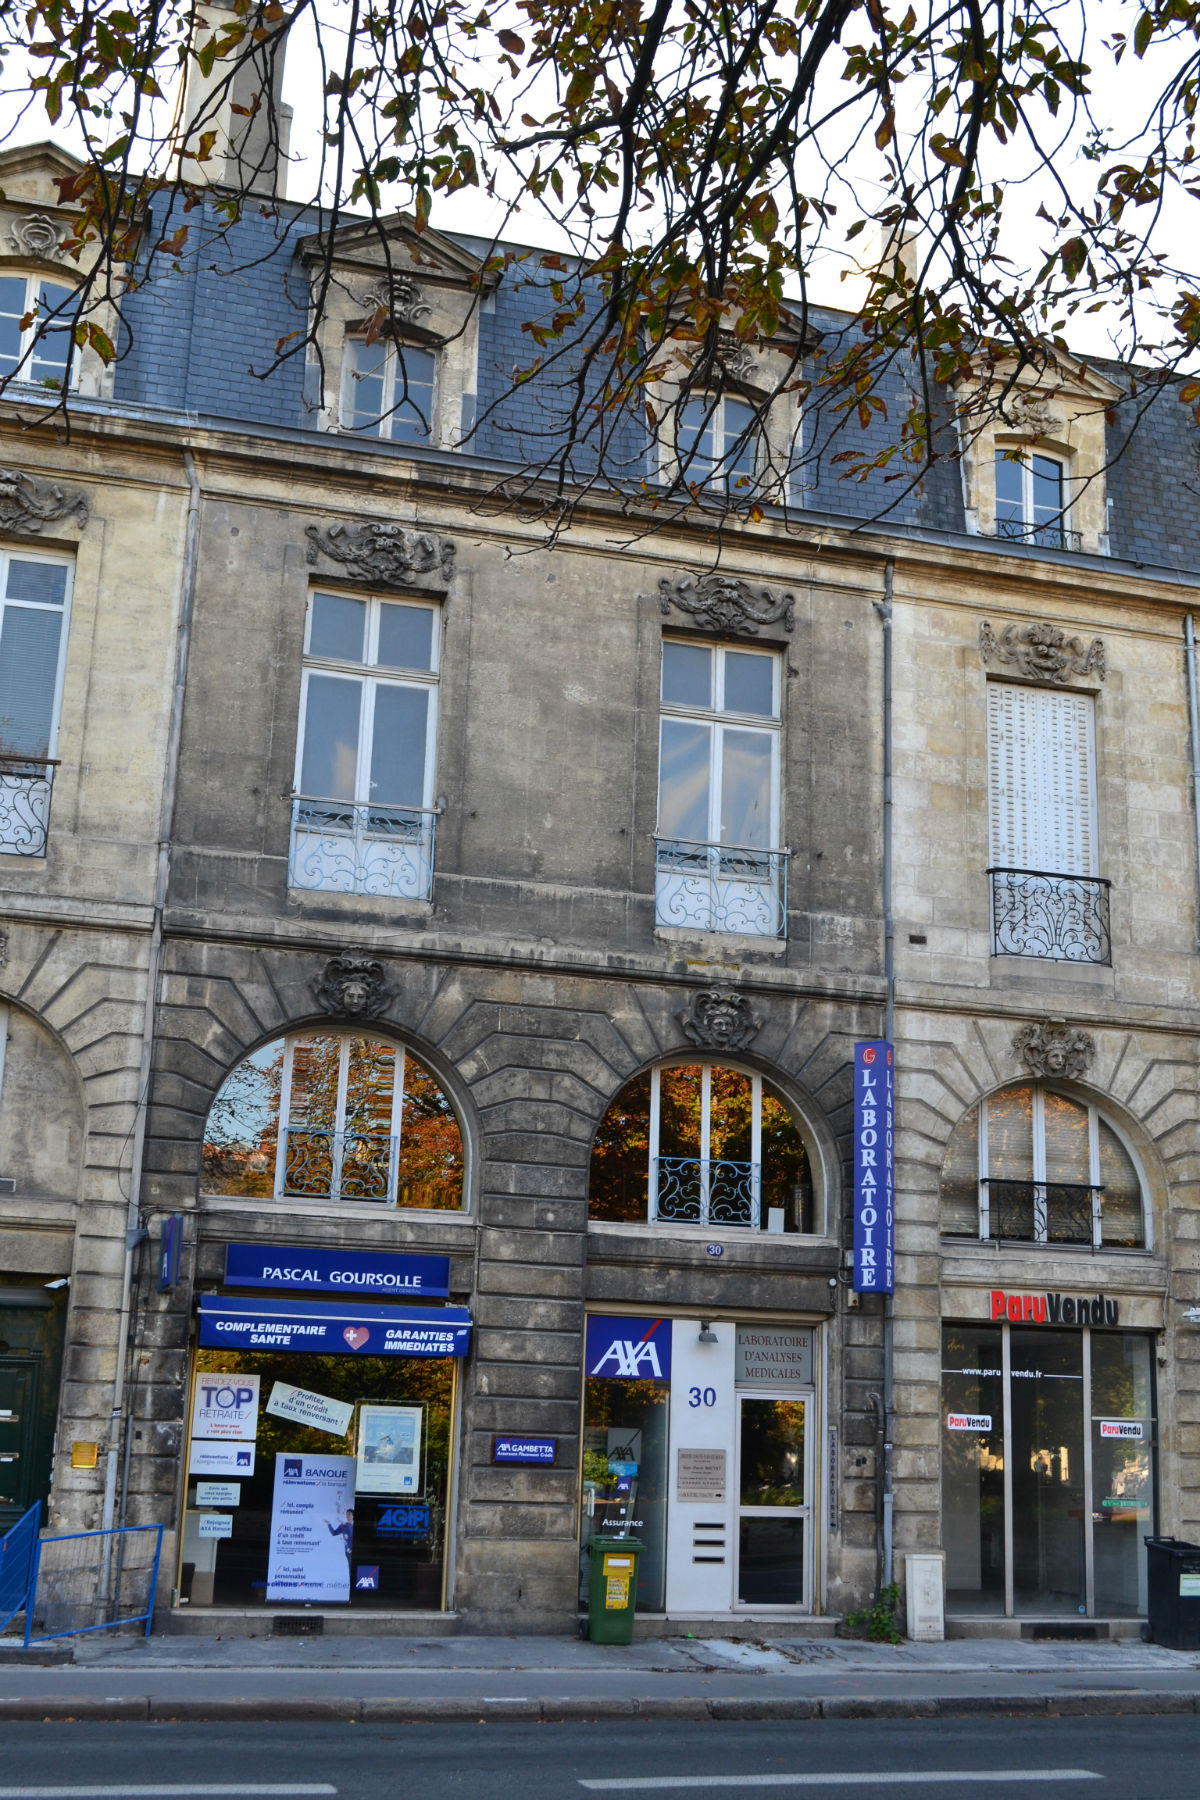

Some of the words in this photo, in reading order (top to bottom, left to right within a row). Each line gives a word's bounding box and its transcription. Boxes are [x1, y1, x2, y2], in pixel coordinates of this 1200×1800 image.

[860, 1069, 878, 1286] LABORATOIRE
[709, 1245, 721, 1255] 30
[262, 1267, 322, 1282] PASCAL
[329, 1271, 422, 1287] GOURSOLLE
[990, 1290, 1119, 1326] ParuVendu
[215, 1321, 327, 1335] COMPLEMENTAIRE
[250, 1334, 291, 1345] SANTE
[385, 1330, 454, 1341] GARANTIES
[738, 1335, 808, 1347] LABORATOIRE
[384, 1340, 455, 1353] IMMEDIATES
[591, 1340, 662, 1377] AXA
[744, 1351, 802, 1363] D'ANALYSES
[745, 1366, 801, 1379] MEDICALES
[962, 1367, 1001, 1377] www.paru
[1011, 1371, 1042, 1379] vendu.fr
[201, 1386, 253, 1409] TOP
[288, 1396, 305, 1407] d'un
[296, 1390, 325, 1405] Profitez
[688, 1387, 716, 1408] 30
[199, 1409, 244, 1420] RETRAITE
[281, 1401, 297, 1412] taux
[300, 1409, 338, 1426] renversant
[949, 1416, 990, 1428] ParuVendu
[1102, 1423, 1141, 1436] ParuVendu
[511, 1444, 553, 1453] GAMBETTA
[607, 1446, 635, 1461] AXA
[305, 1469, 348, 1479] BANQUE
[377, 1509, 429, 1527] AGIPI
[602, 1519, 643, 1527] Assurance
[356, 1577, 375, 1587] AXA
